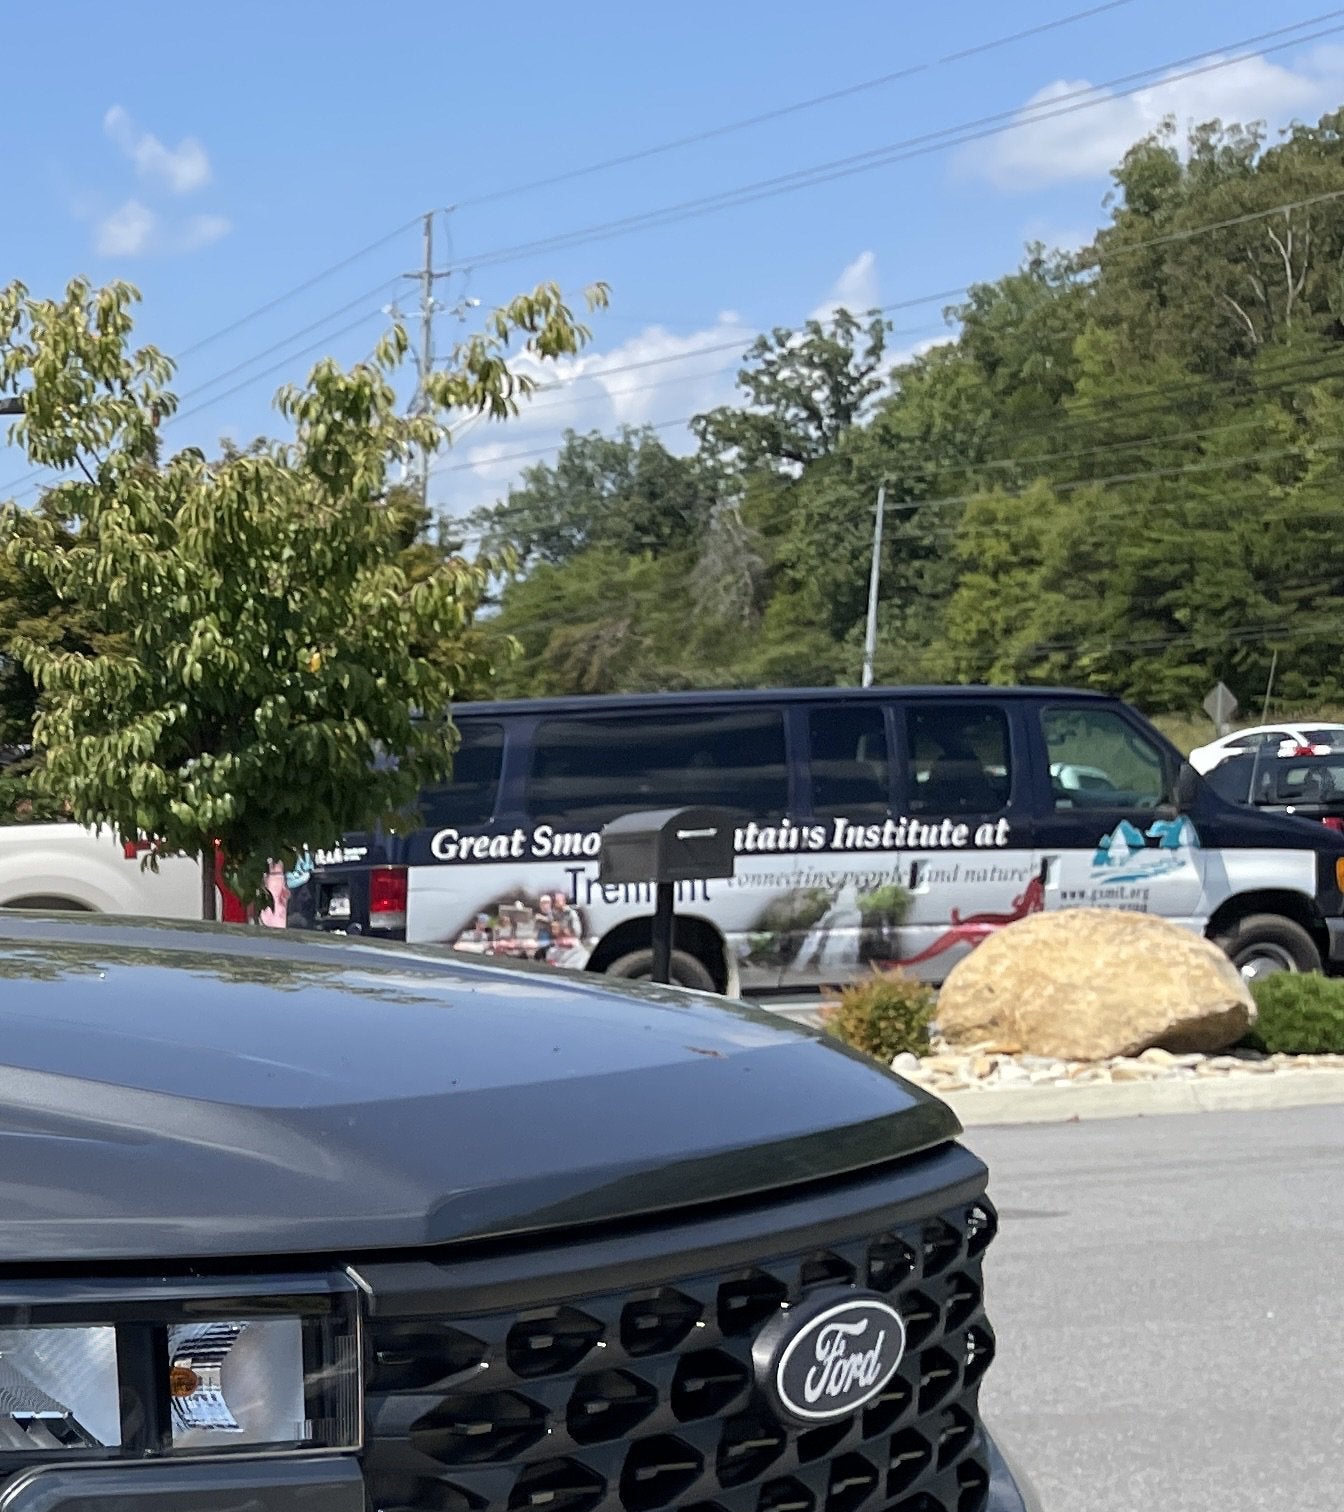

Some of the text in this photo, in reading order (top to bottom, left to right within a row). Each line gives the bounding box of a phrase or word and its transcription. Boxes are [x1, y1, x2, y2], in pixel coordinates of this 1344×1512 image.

[430, 815, 1010, 861] Great Smo tains Institute at
[564, 866, 711, 906] Tremnt
[804, 1318, 886, 1403] Ford
